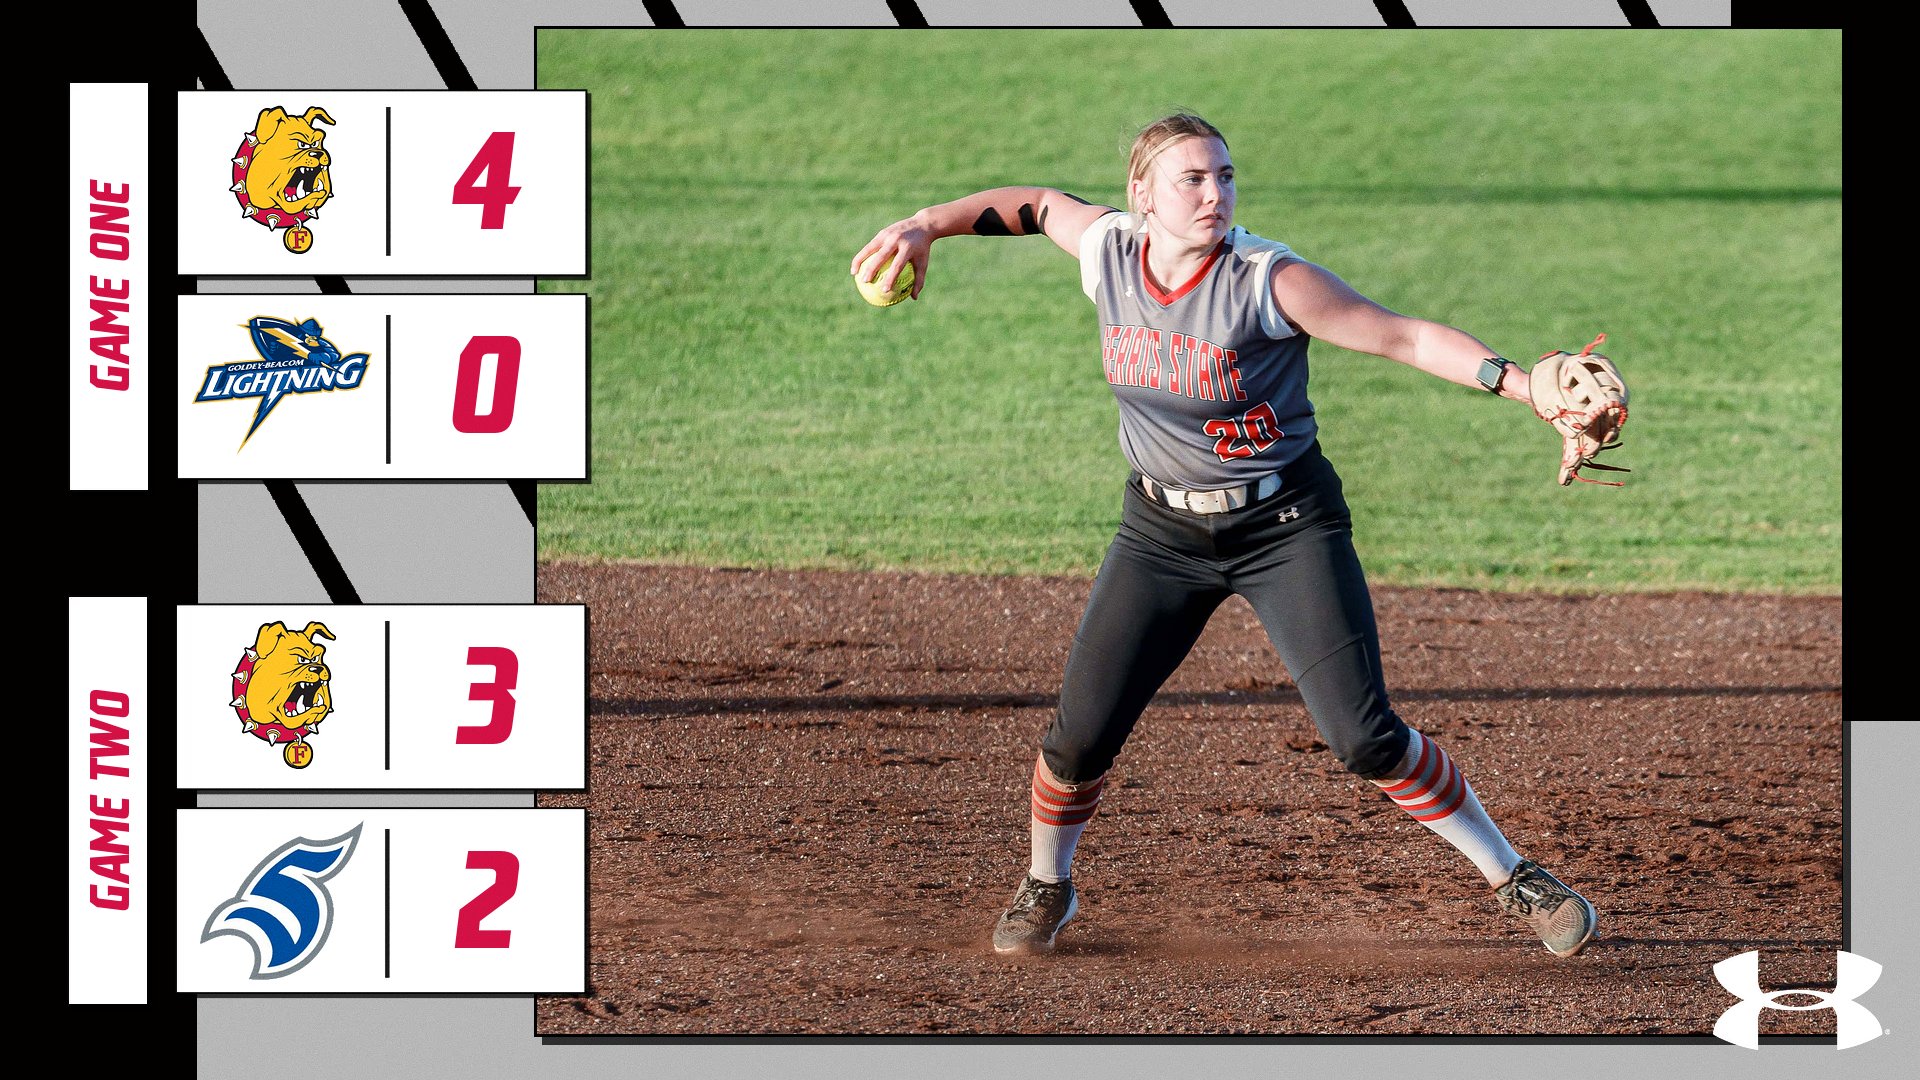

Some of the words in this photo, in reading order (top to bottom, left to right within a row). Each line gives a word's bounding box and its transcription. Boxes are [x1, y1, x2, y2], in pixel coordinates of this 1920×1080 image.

[1103, 324, 1163, 391] FERRIS
[1168, 330, 1249, 402] STATE
[1201, 401, 1286, 464] 20
